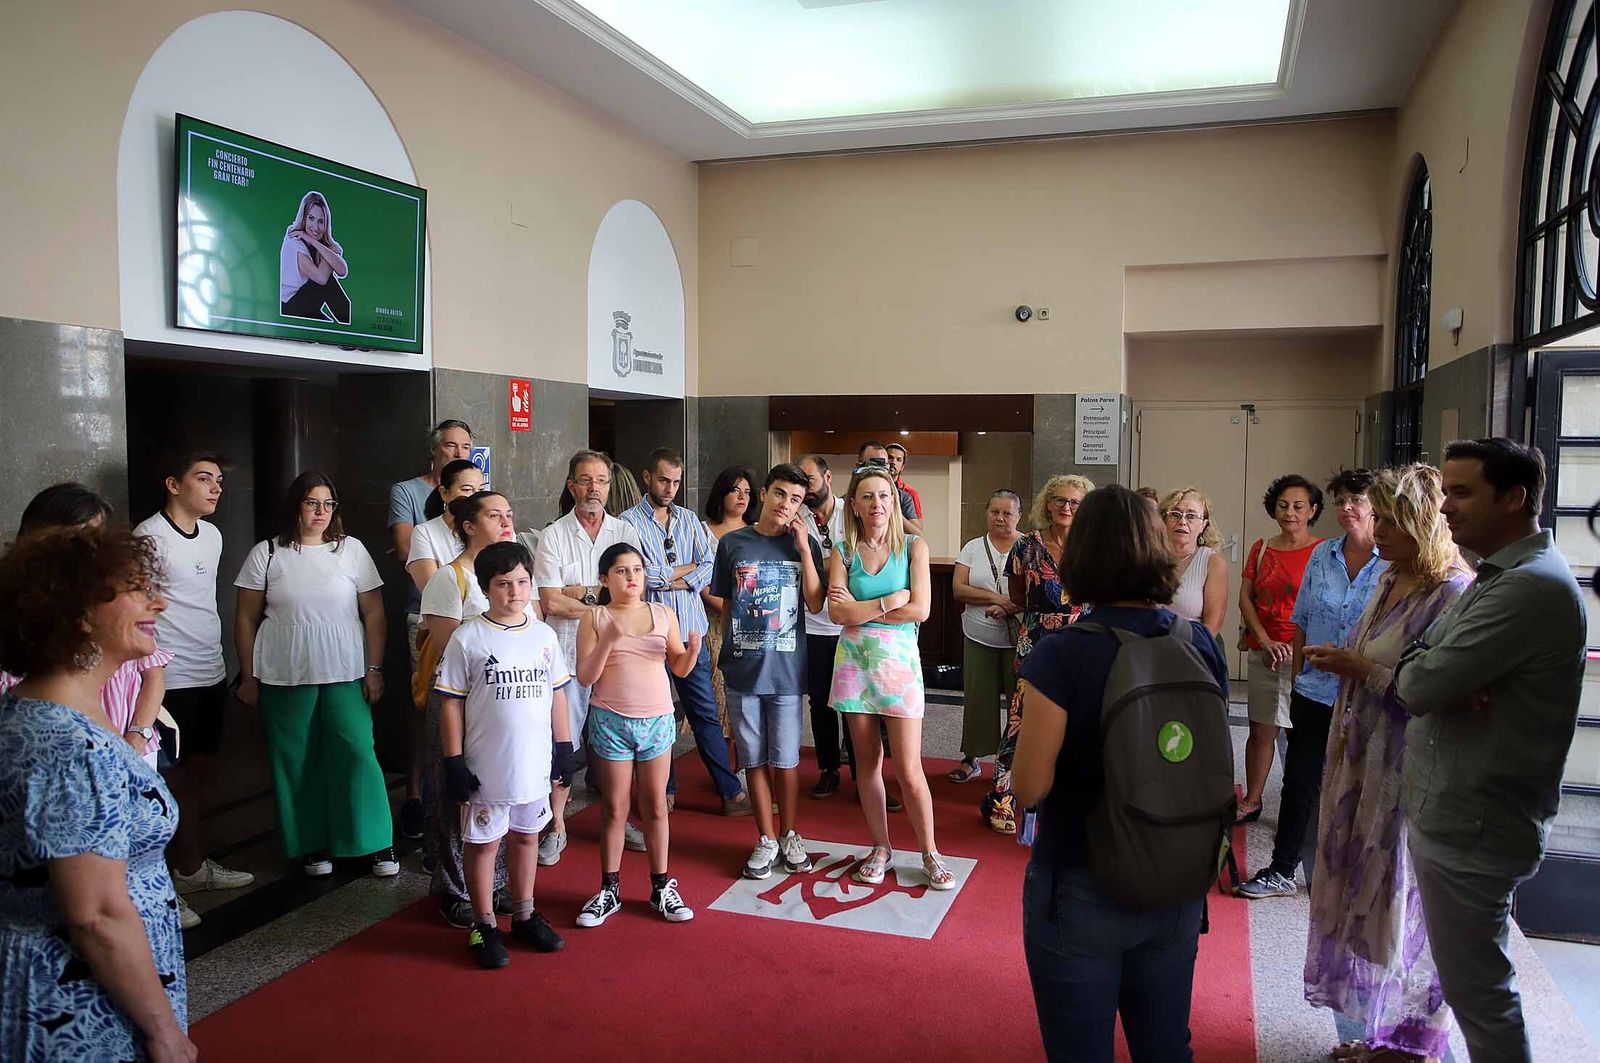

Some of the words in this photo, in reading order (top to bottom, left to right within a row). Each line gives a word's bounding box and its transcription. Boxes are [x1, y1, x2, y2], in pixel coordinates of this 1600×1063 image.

[215, 149, 248, 166] CONCIERTO
[208, 157, 219, 169] FIN
[219, 160, 255, 179] CENTENARIO
[213, 170, 231, 182] GRAN
[753, 585, 779, 597] MEMORY
[496, 686, 512, 700] FLY
[515, 685, 542, 699] BETTER
